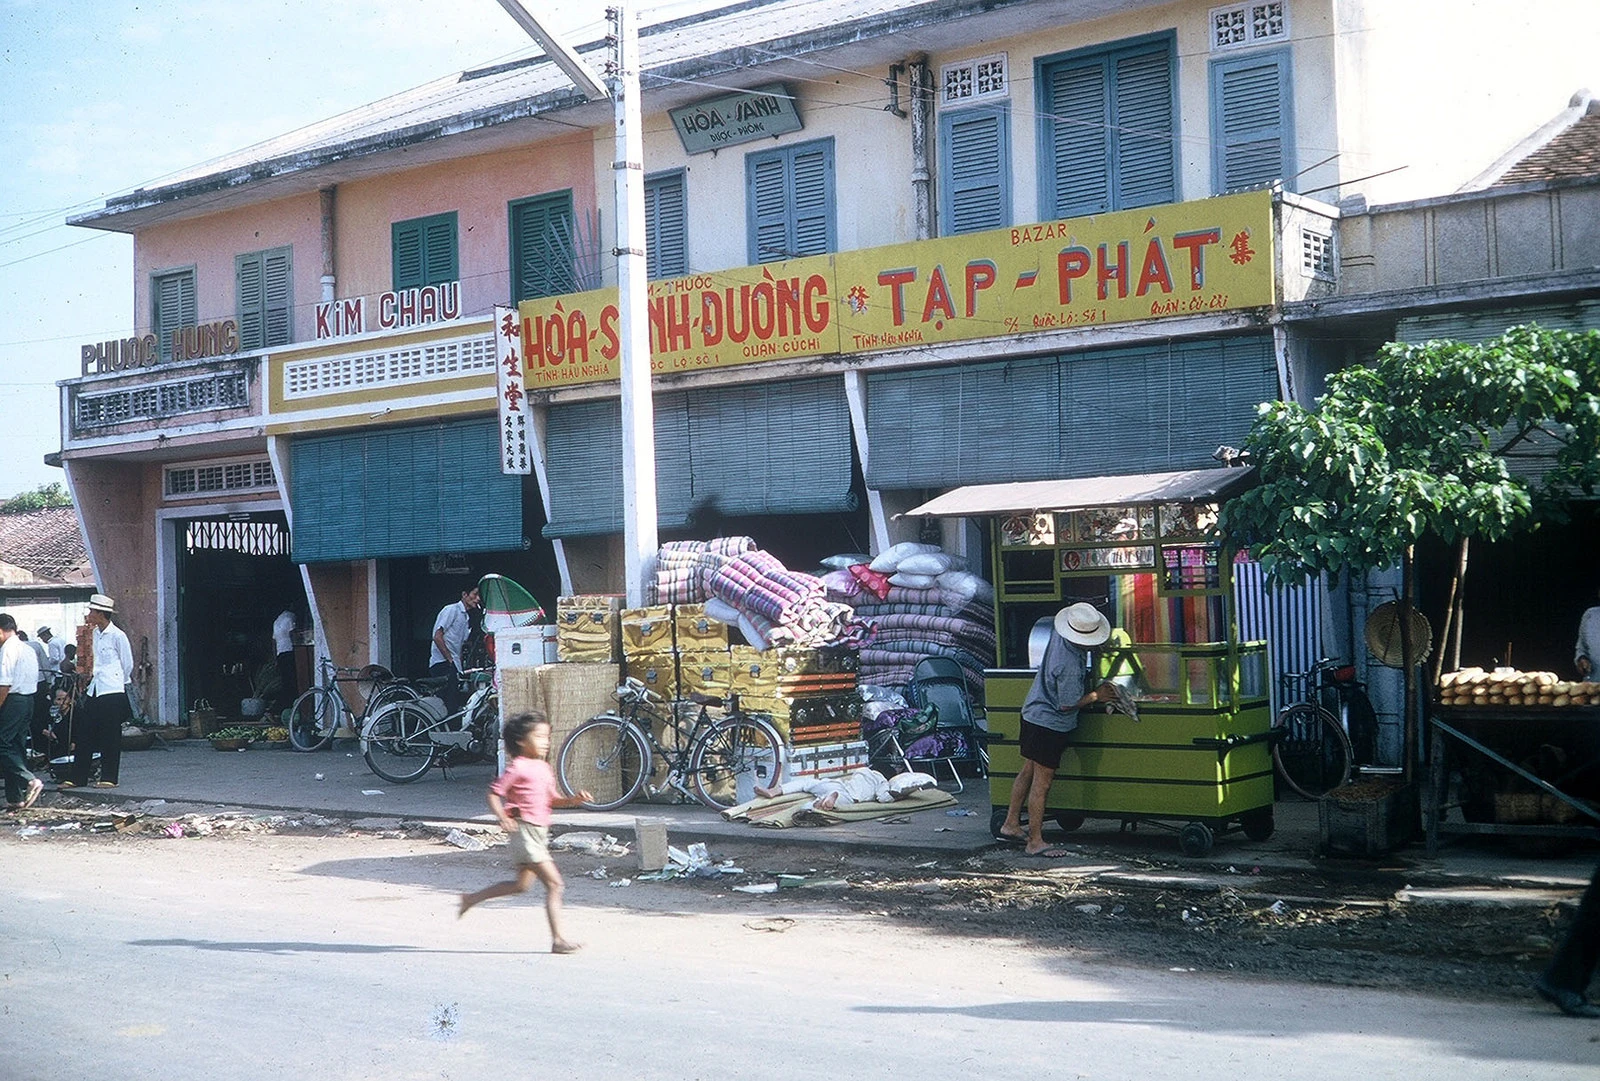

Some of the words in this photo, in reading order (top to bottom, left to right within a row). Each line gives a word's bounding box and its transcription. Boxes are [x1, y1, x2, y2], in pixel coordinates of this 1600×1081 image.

[1011, 223, 1067, 246] BAZAR
[1228, 231, 1256, 266] 集
[877, 257, 999, 331] TẠP
[1057, 216, 1222, 306] PHÁT
[379, 281, 461, 329] CHAU
[1102, 309, 1106, 322] 1
[171, 319, 241, 362] HUNG
[715, 353, 719, 364] 1
[501, 313, 523, 411] 和生堂
